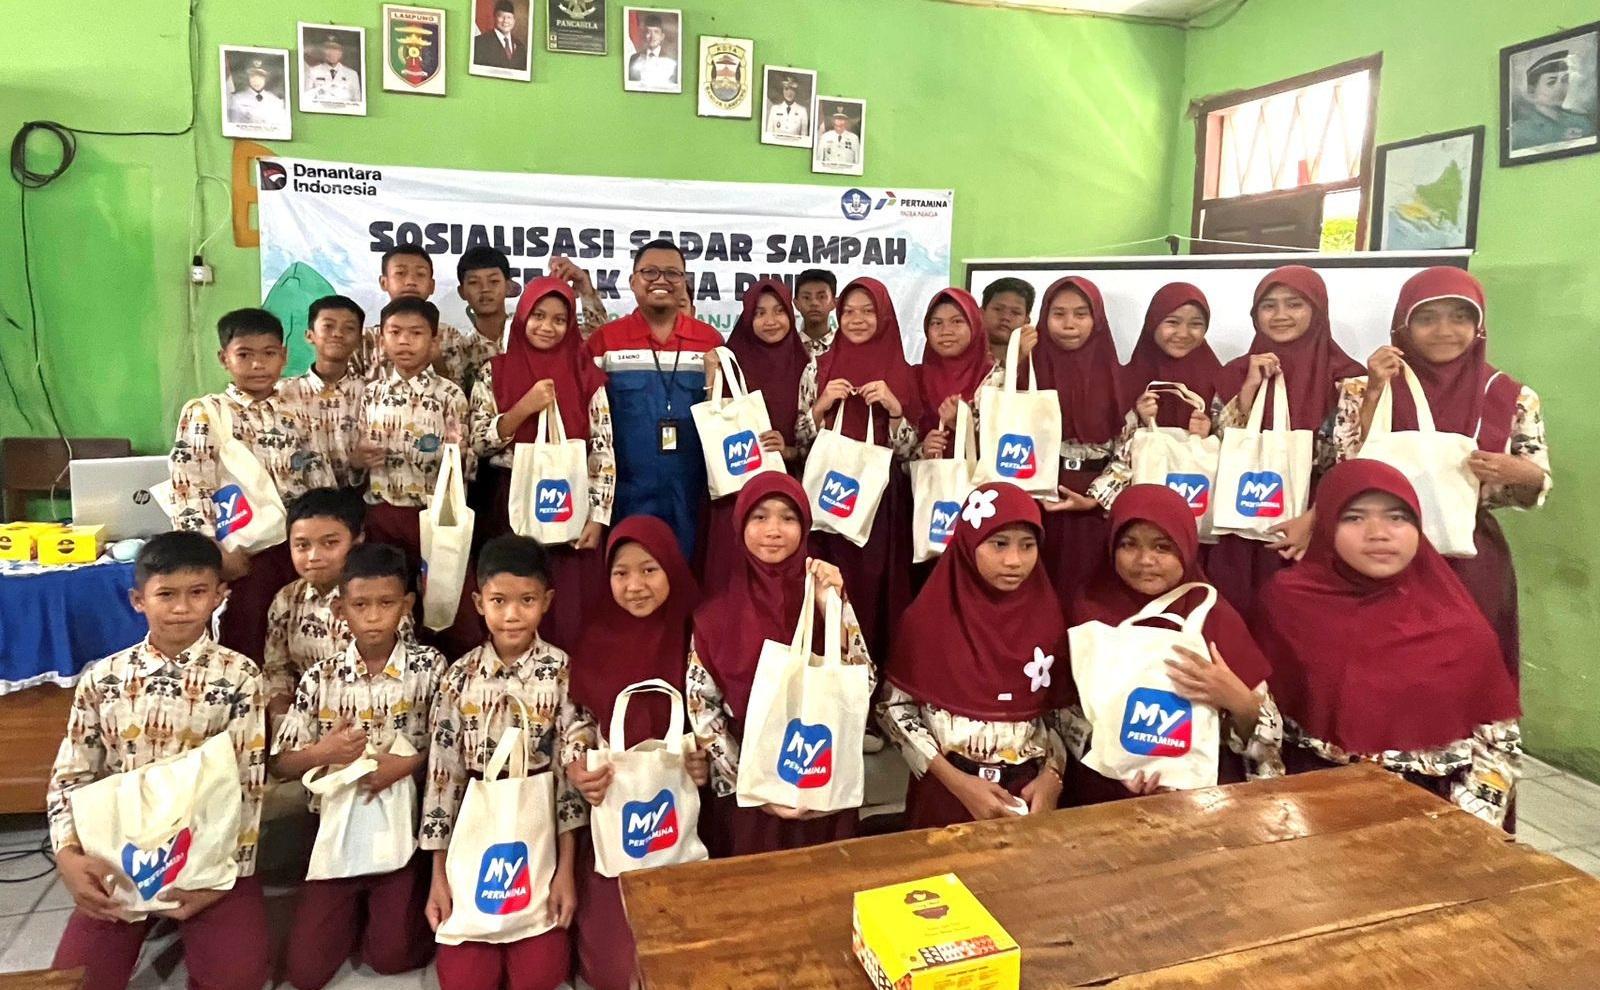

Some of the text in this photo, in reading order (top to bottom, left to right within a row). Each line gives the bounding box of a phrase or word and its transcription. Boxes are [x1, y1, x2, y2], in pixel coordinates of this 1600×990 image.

[293, 163, 382, 181] Danantara
[293, 179, 377, 196] Indonesia
[900, 199, 948, 208] PERTAMINA
[368, 220, 614, 258] SOSIALISASI
[767, 234, 906, 266] SAMPAH
[134, 490, 150, 504] hp
[1127, 730, 1186, 749] PERTAMINA
[481, 886, 526, 900] PERTAMINA
